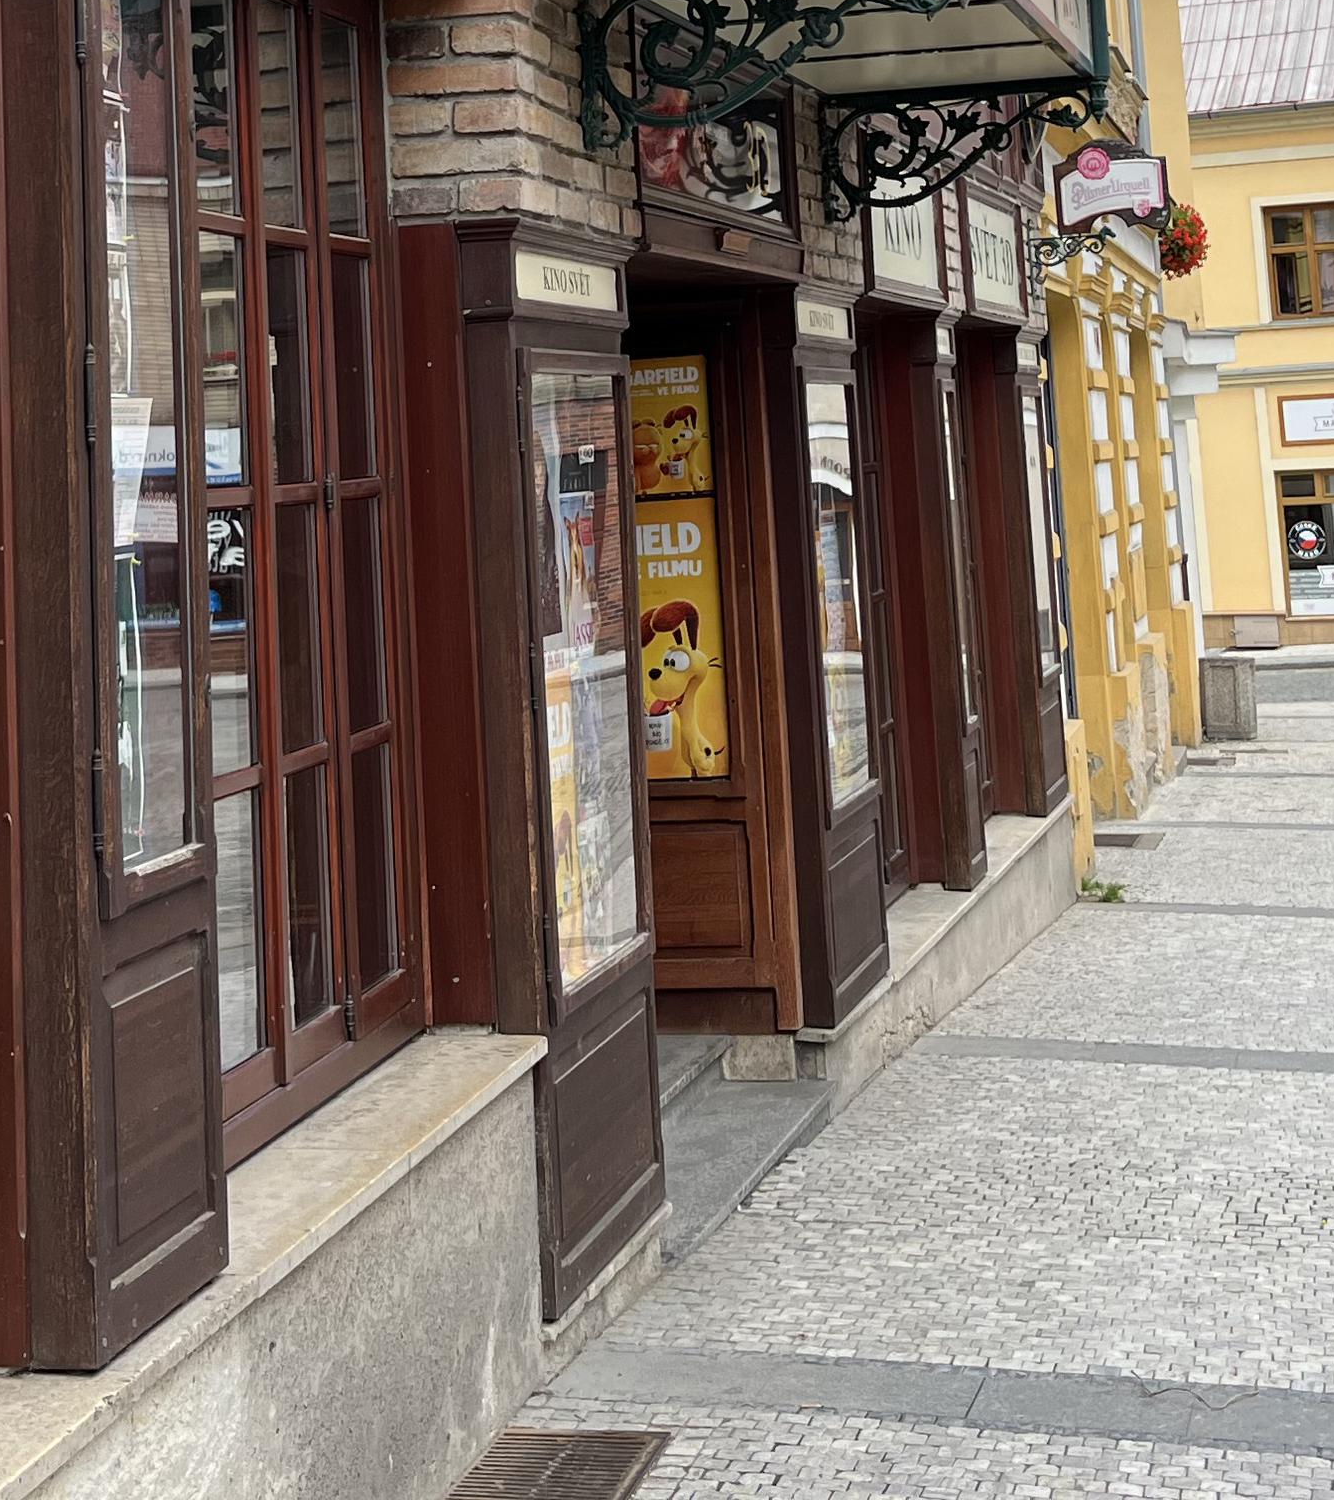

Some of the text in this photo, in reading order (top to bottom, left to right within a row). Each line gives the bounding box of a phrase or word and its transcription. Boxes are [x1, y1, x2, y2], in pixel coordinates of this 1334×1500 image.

[882, 192, 922, 260] KINO
[969, 213, 998, 283] SVĚT
[542, 265, 591, 297] KINO SVĚT
[648, 559, 703, 579] FILMU
